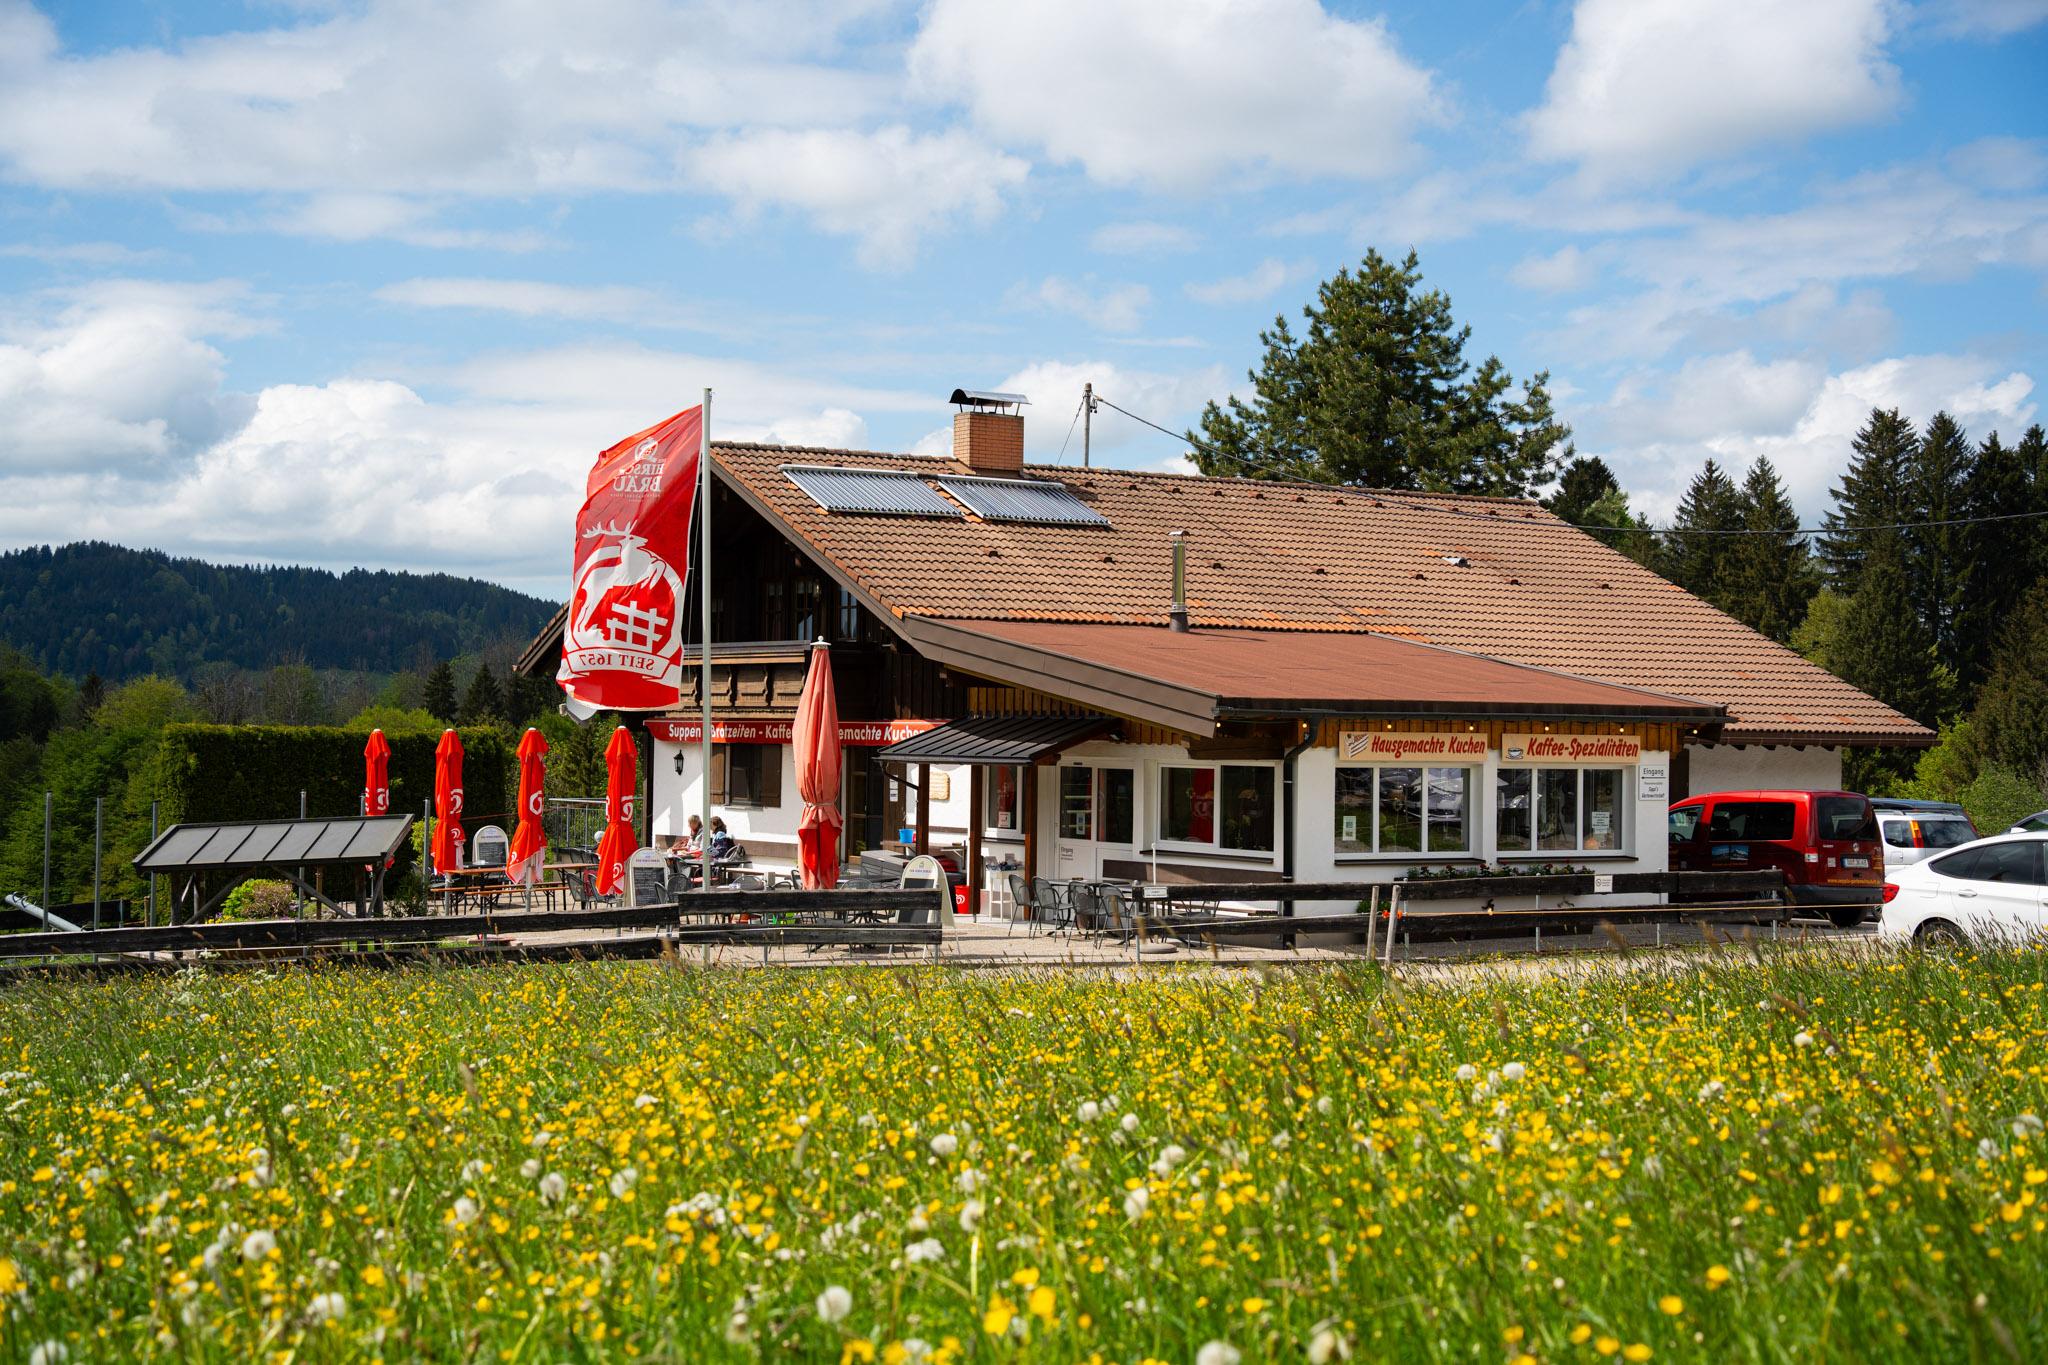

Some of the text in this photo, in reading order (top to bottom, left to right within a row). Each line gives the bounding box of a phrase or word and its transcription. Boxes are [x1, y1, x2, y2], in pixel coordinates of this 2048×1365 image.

[668, 723, 702, 741] Suppen
[765, 724, 793, 740] Kaffe
[838, 725, 882, 741] emachte
[1371, 735, 1486, 759] Hausgemachte Kuchen
[1526, 737, 1639, 761] Kaffee-Spezialitäten
[1643, 767, 1665, 777] Eingang
